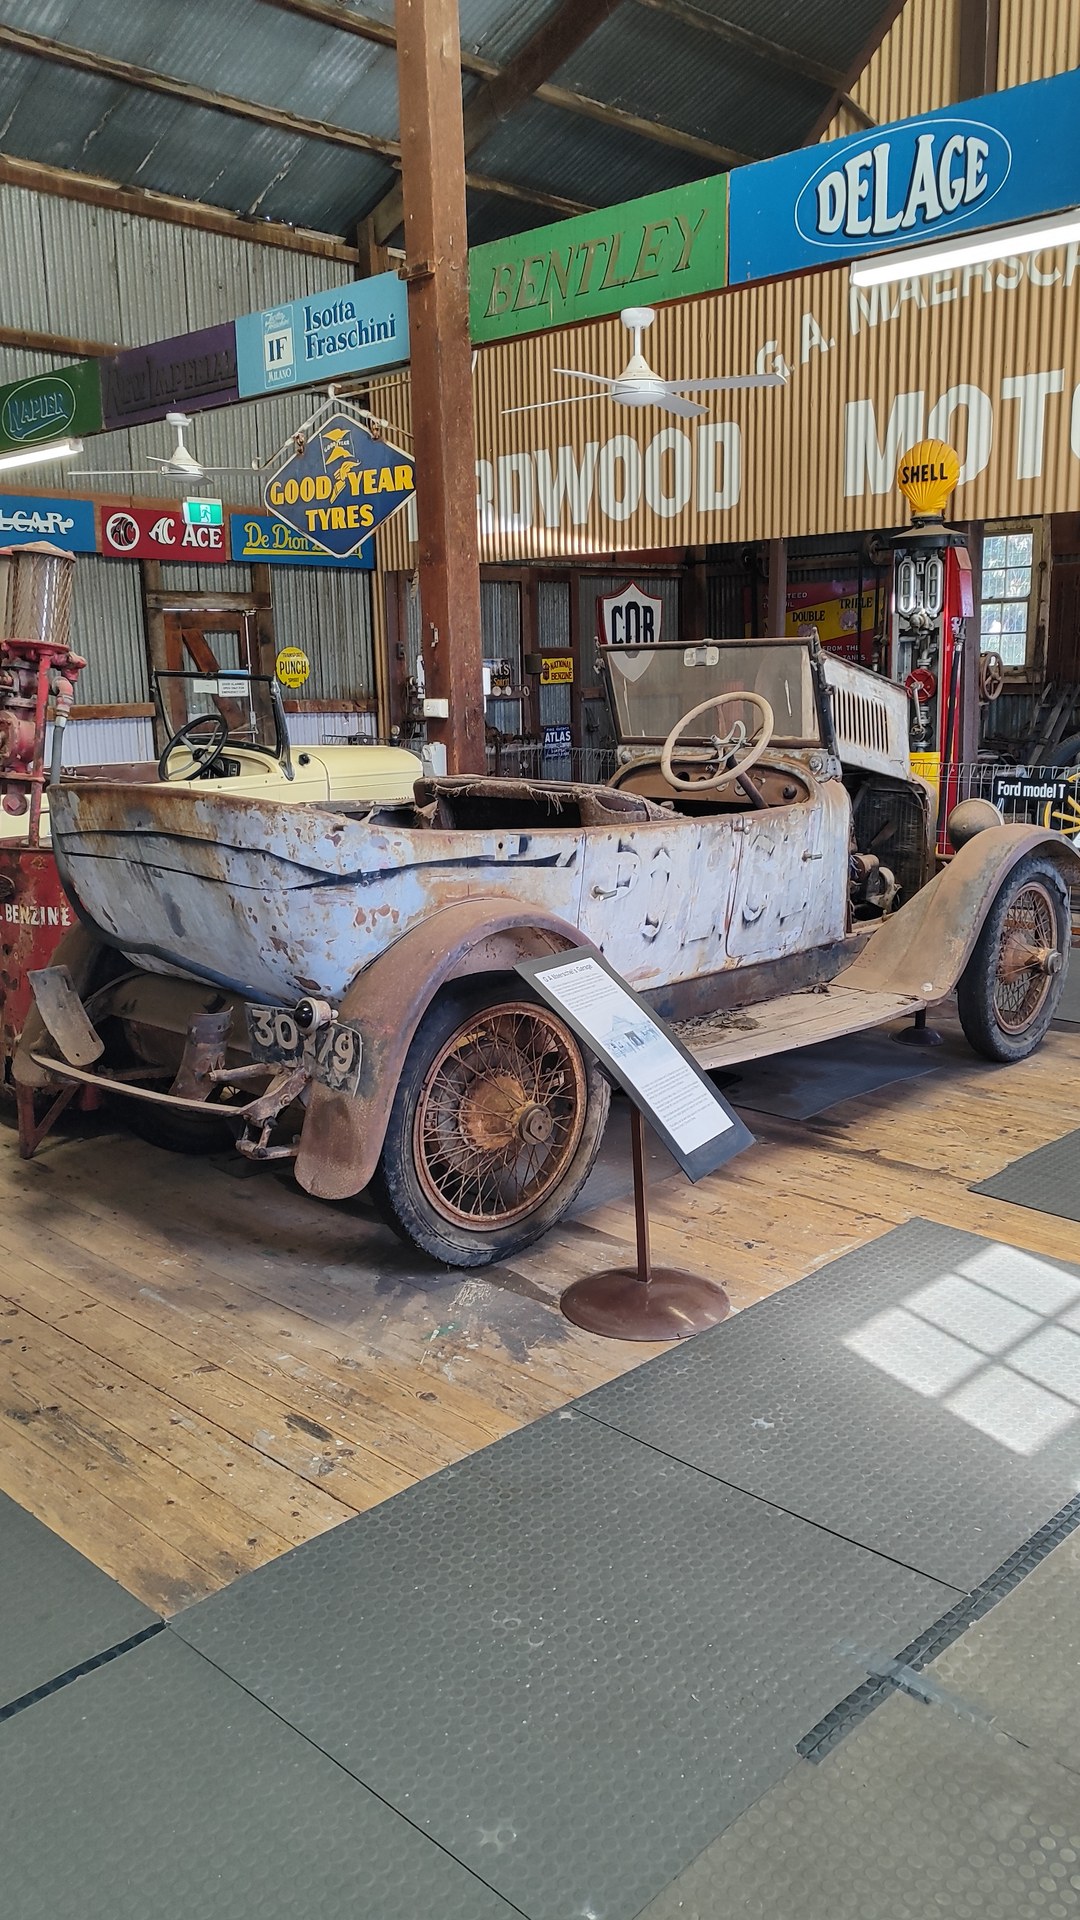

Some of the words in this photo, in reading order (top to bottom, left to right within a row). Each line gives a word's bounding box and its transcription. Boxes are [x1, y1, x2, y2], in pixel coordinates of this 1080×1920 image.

[816, 134, 989, 236] DELAGE
[483, 208, 709, 319] BENTLEY
[303, 299, 357, 334] Isotta
[267, 336, 288, 362] IF
[304, 313, 397, 362] Fraschini
[800, 312, 836, 364] A.
[267, 368, 292, 384] MILANO
[7, 392, 64, 434] NAPIER
[843, 368, 1080, 498] MOT
[901, 462, 948, 485] SHELL
[305, 503, 375, 532] TYRES
[149, 517, 177, 546] AC
[181, 524, 223, 549] ACE
[244, 522, 270, 548] De
[272, 523, 309, 550] Dion
[792, 610, 826, 623] DOUBLE
[279, 660, 307, 675] PUNCH
[545, 730, 571, 743] ATLAS
[997, 781, 1022, 796] Ford
[1023, 783, 1057, 799] model
[1058, 784, 1066, 799] T
[5, 903, 72, 926] BENZINE
